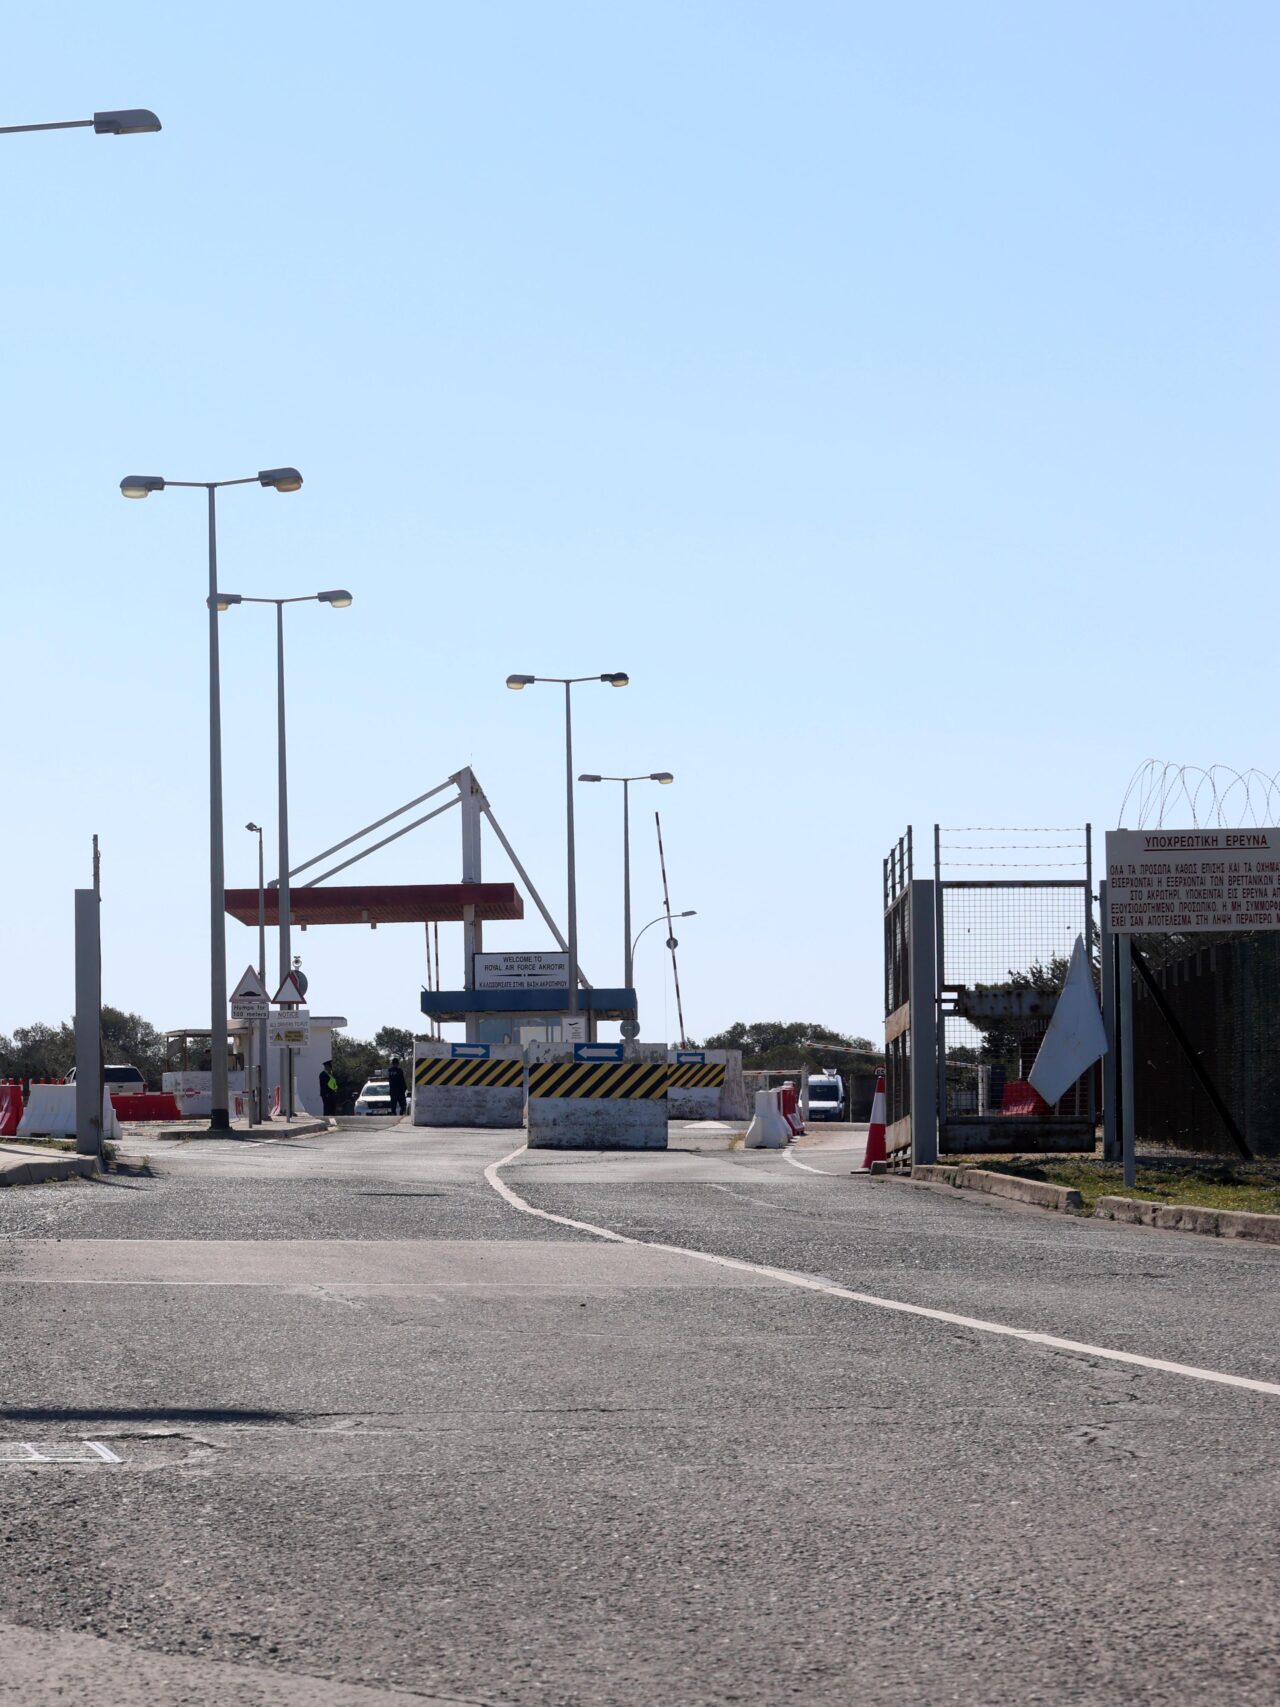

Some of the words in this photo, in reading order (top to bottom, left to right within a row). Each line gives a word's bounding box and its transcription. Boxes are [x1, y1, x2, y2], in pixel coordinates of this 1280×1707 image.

[1145, 836, 1218, 848] ΥΠΟΧΡΕΩΤΙΚΗ
[1226, 835, 1267, 846] ΕΡΕΥΝΑ
[1110, 864, 1123, 875] ΟΛΑ
[1128, 864, 1136, 874] ΤΑ
[1140, 864, 1171, 874] ΠΡΟΣΩΠΑ
[1175, 863, 1197, 874] ΚΑΘΩΣ
[1228, 863, 1239, 872] ΚΑΙ
[1244, 862, 1252, 872] ΤΑ
[1256, 862, 1280, 872] ΟΧΗΜΑ
[1112, 876, 1153, 888] ΕΙΣΕΡΧΟΝΤΑΙ
[1157, 876, 1162, 887] Η
[1167, 875, 1206, 888] ΕΞΕΡΧΟΝΤΑΙ
[1210, 876, 1223, 886] ΤΩΝ
[1130, 890, 1143, 901] ΣΤΟ
[1186, 888, 1223, 899] ΥΠΟΚΕΙΝΤΑΙ
[1228, 889, 1238, 898] ΕΙΣ
[1242, 888, 1268, 898] ΕΡΕΥΝΑ
[1232, 902, 1241, 911] ΜΗ
[1112, 916, 1126, 927] ΕΧΕΙ
[1131, 916, 1143, 926] ΣΑΝ
[1148, 915, 1191, 926] ΑΠΟΤΕΛΕΣΜΑ
[1196, 914, 1208, 925] ΣΤΗ
